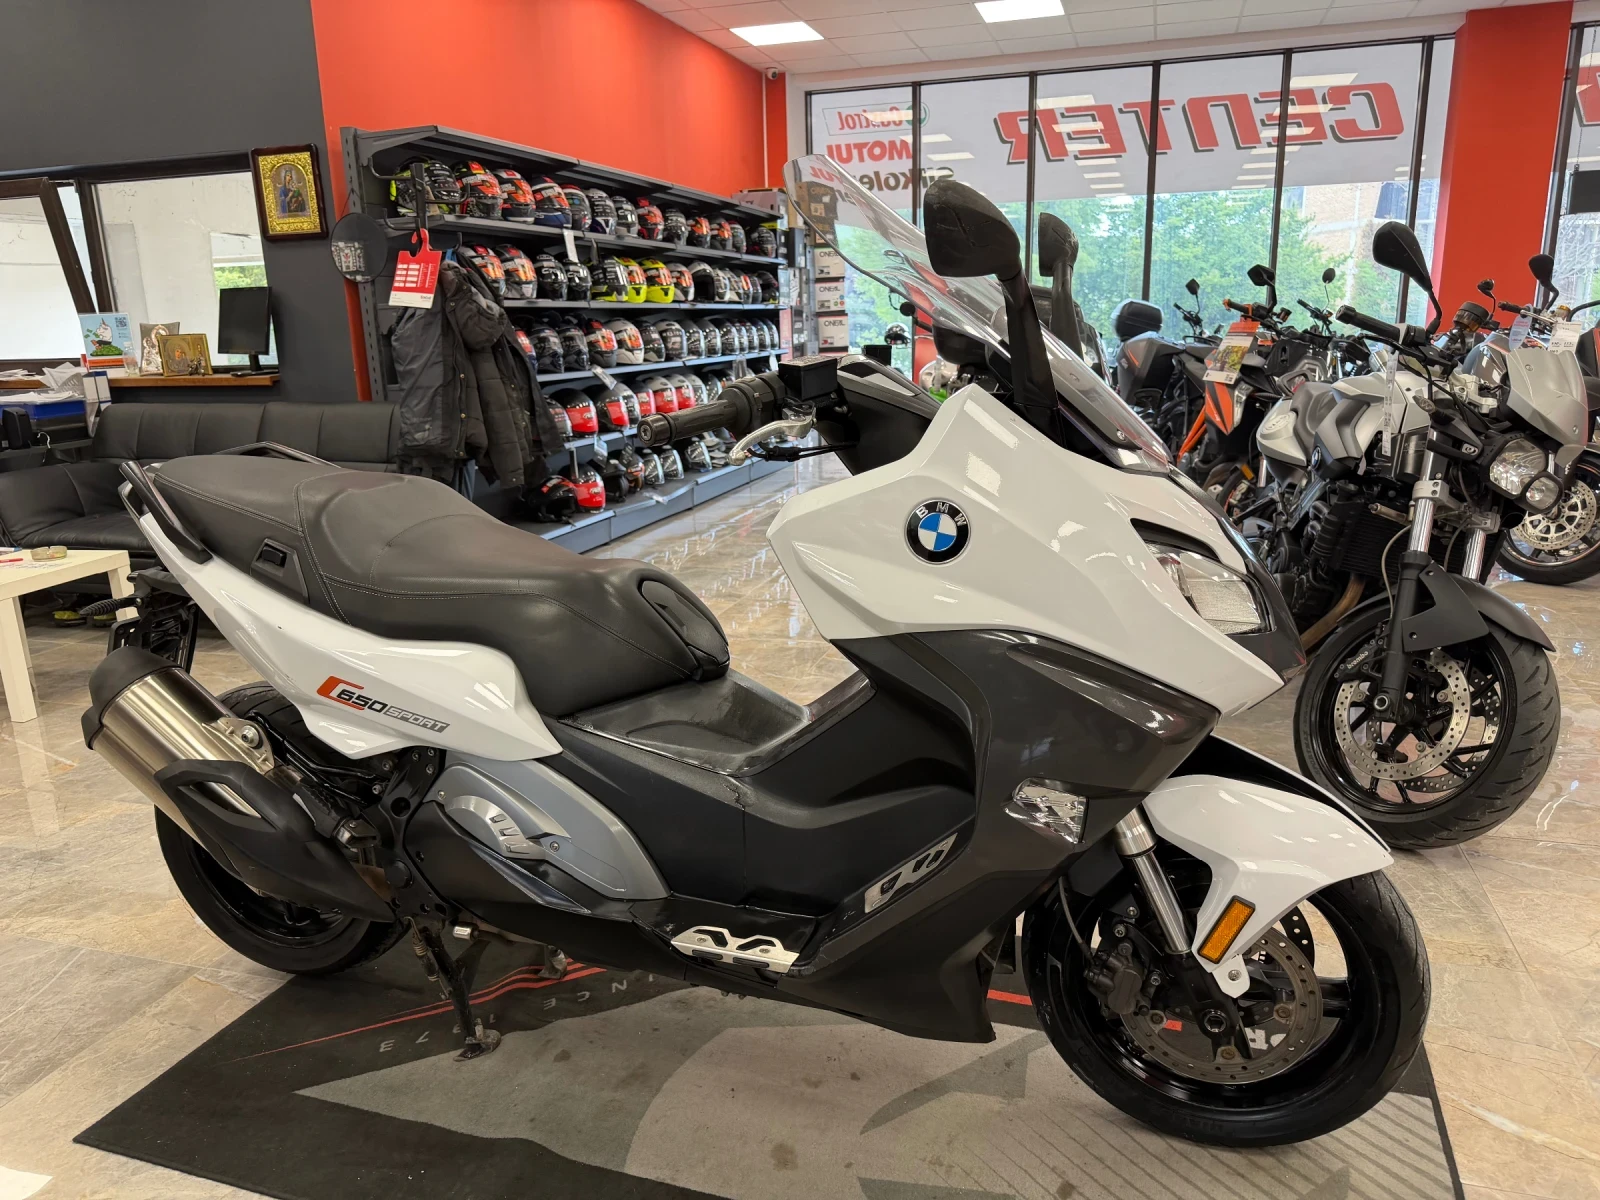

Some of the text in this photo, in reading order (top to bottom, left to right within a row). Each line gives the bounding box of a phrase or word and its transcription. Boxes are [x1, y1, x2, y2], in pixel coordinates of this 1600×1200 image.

[915, 501, 967, 527] BMW
[1346, 651, 1369, 669] brembo
[384, 706, 449, 733] SPORT
[543, 973, 654, 1011] INCE
